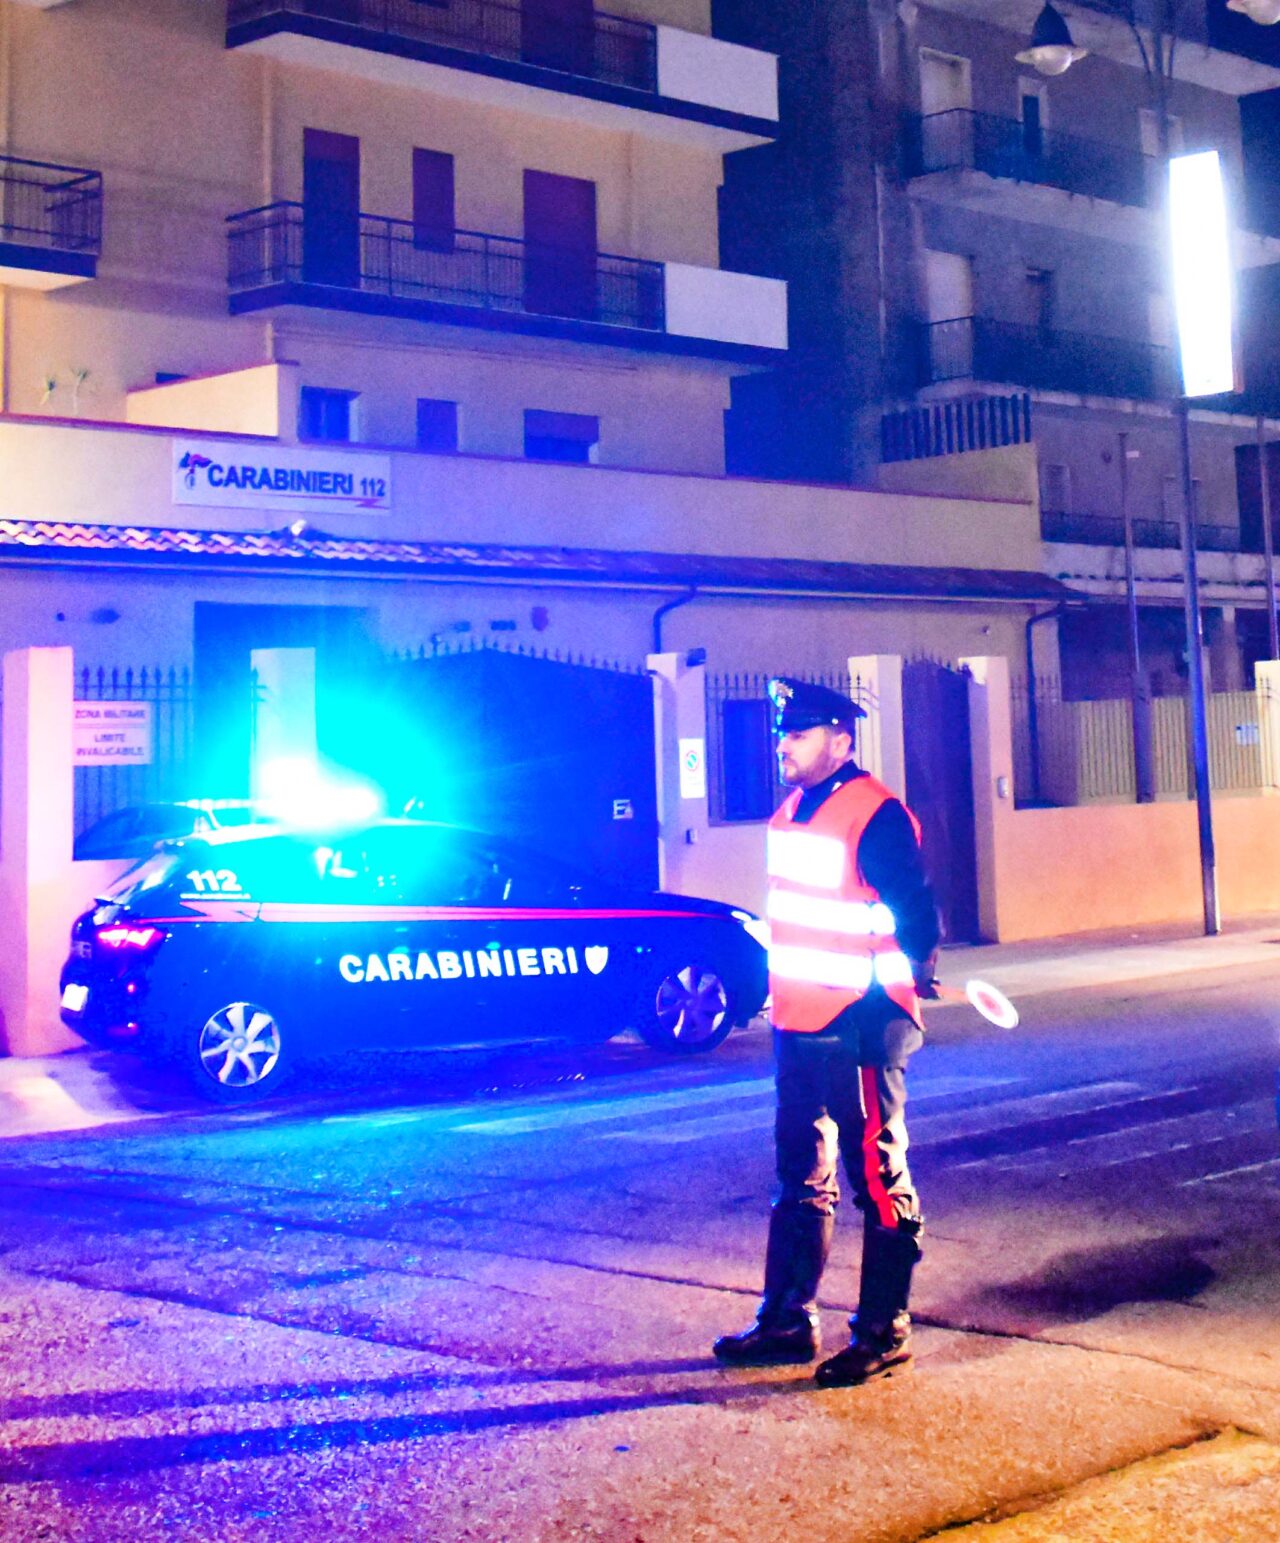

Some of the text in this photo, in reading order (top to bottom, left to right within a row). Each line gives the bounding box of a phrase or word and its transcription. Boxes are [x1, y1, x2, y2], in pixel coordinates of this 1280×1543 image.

[208, 463, 386, 497] CARABINIERI 112
[186, 869, 242, 892] 112
[339, 946, 579, 983] CARABINIERI
